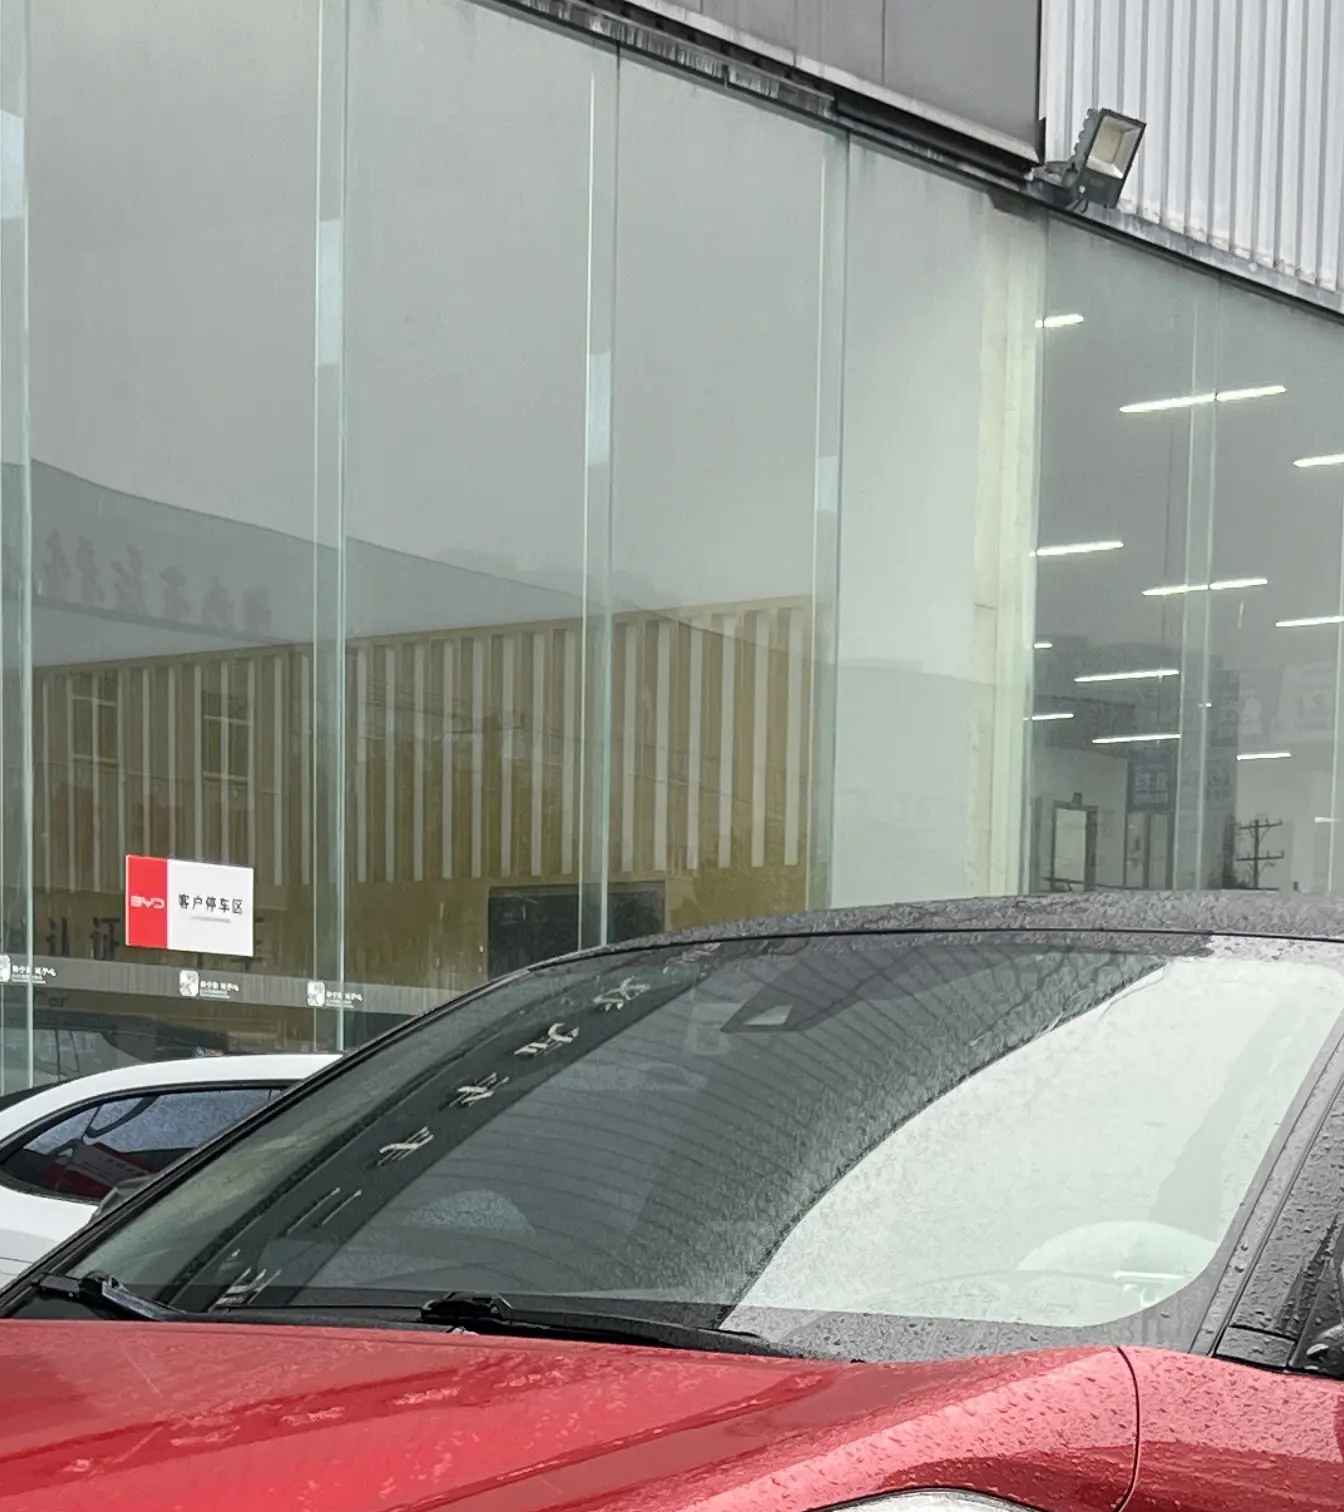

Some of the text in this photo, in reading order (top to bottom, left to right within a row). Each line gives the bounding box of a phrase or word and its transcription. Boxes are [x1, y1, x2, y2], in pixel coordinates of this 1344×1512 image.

[131, 895, 165, 909] BYD
[178, 893, 243, 914] 客户停车区
